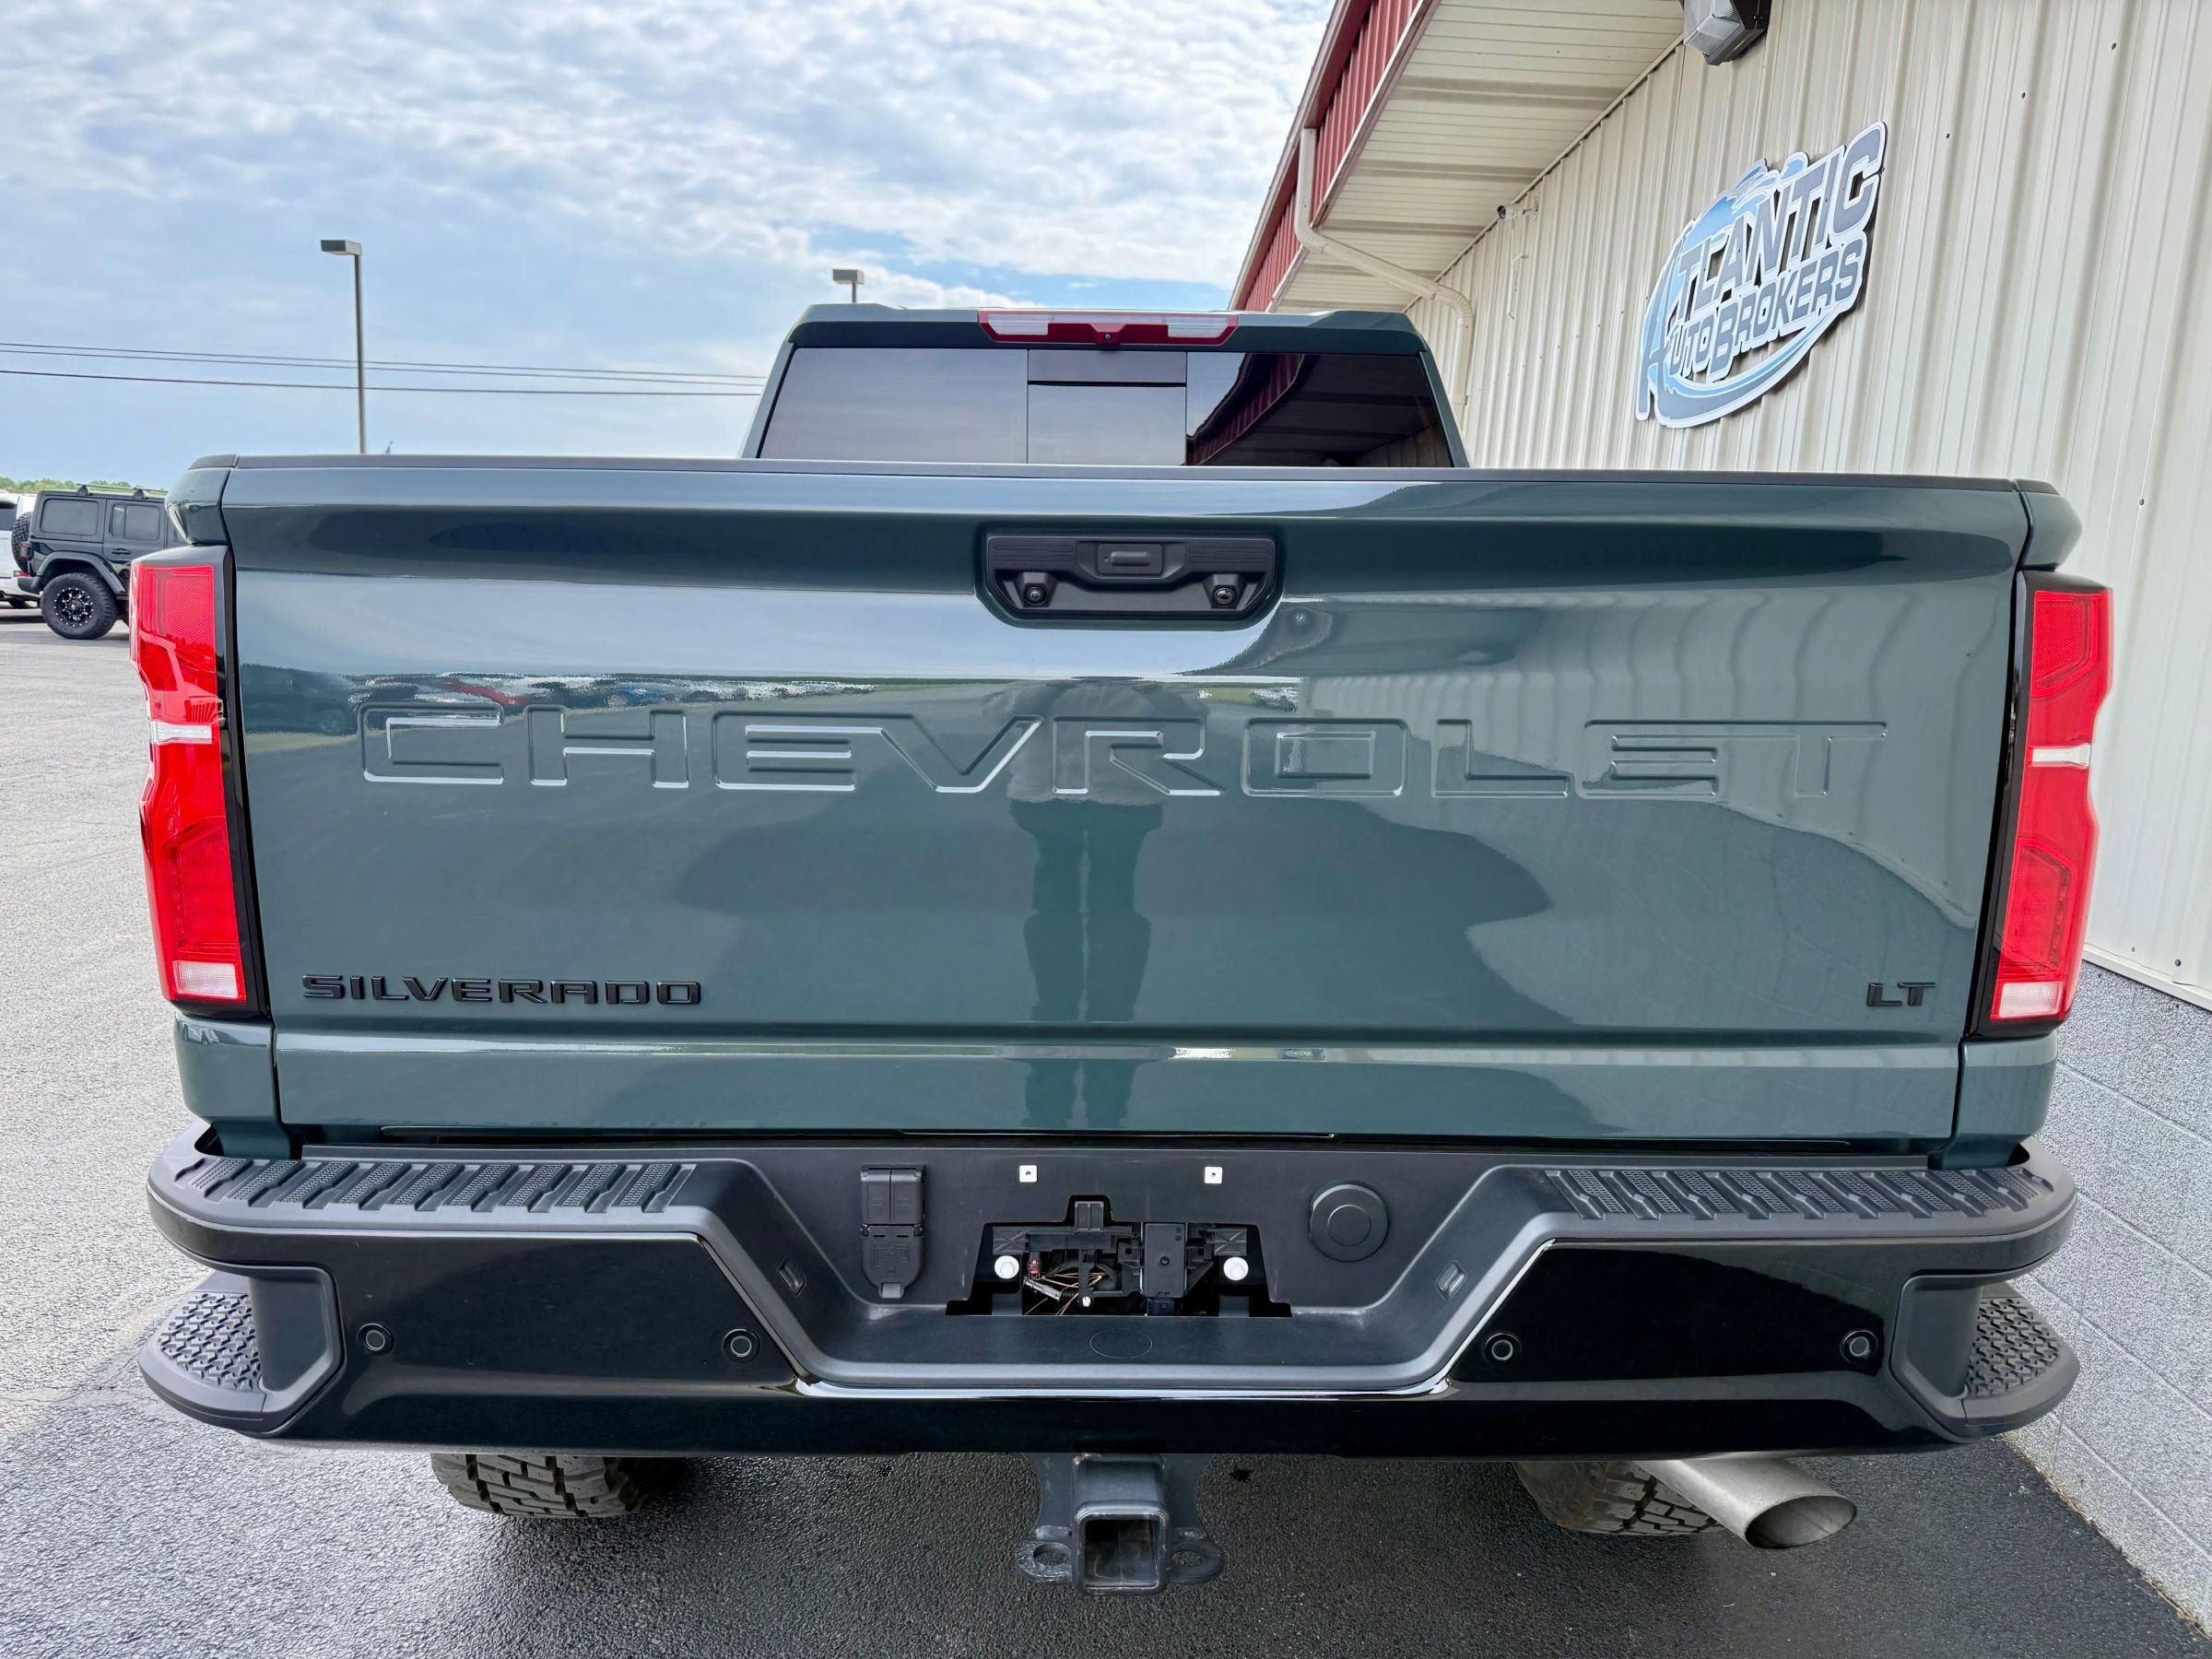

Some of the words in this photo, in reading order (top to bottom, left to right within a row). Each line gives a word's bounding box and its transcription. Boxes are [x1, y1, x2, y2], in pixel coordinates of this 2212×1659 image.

[1638, 126, 1883, 415] ATLANTIC
[360, 701, 1888, 800] CHEVROLET
[302, 973, 701, 1006] SILVERADO
[1866, 982, 1937, 1007] LT
